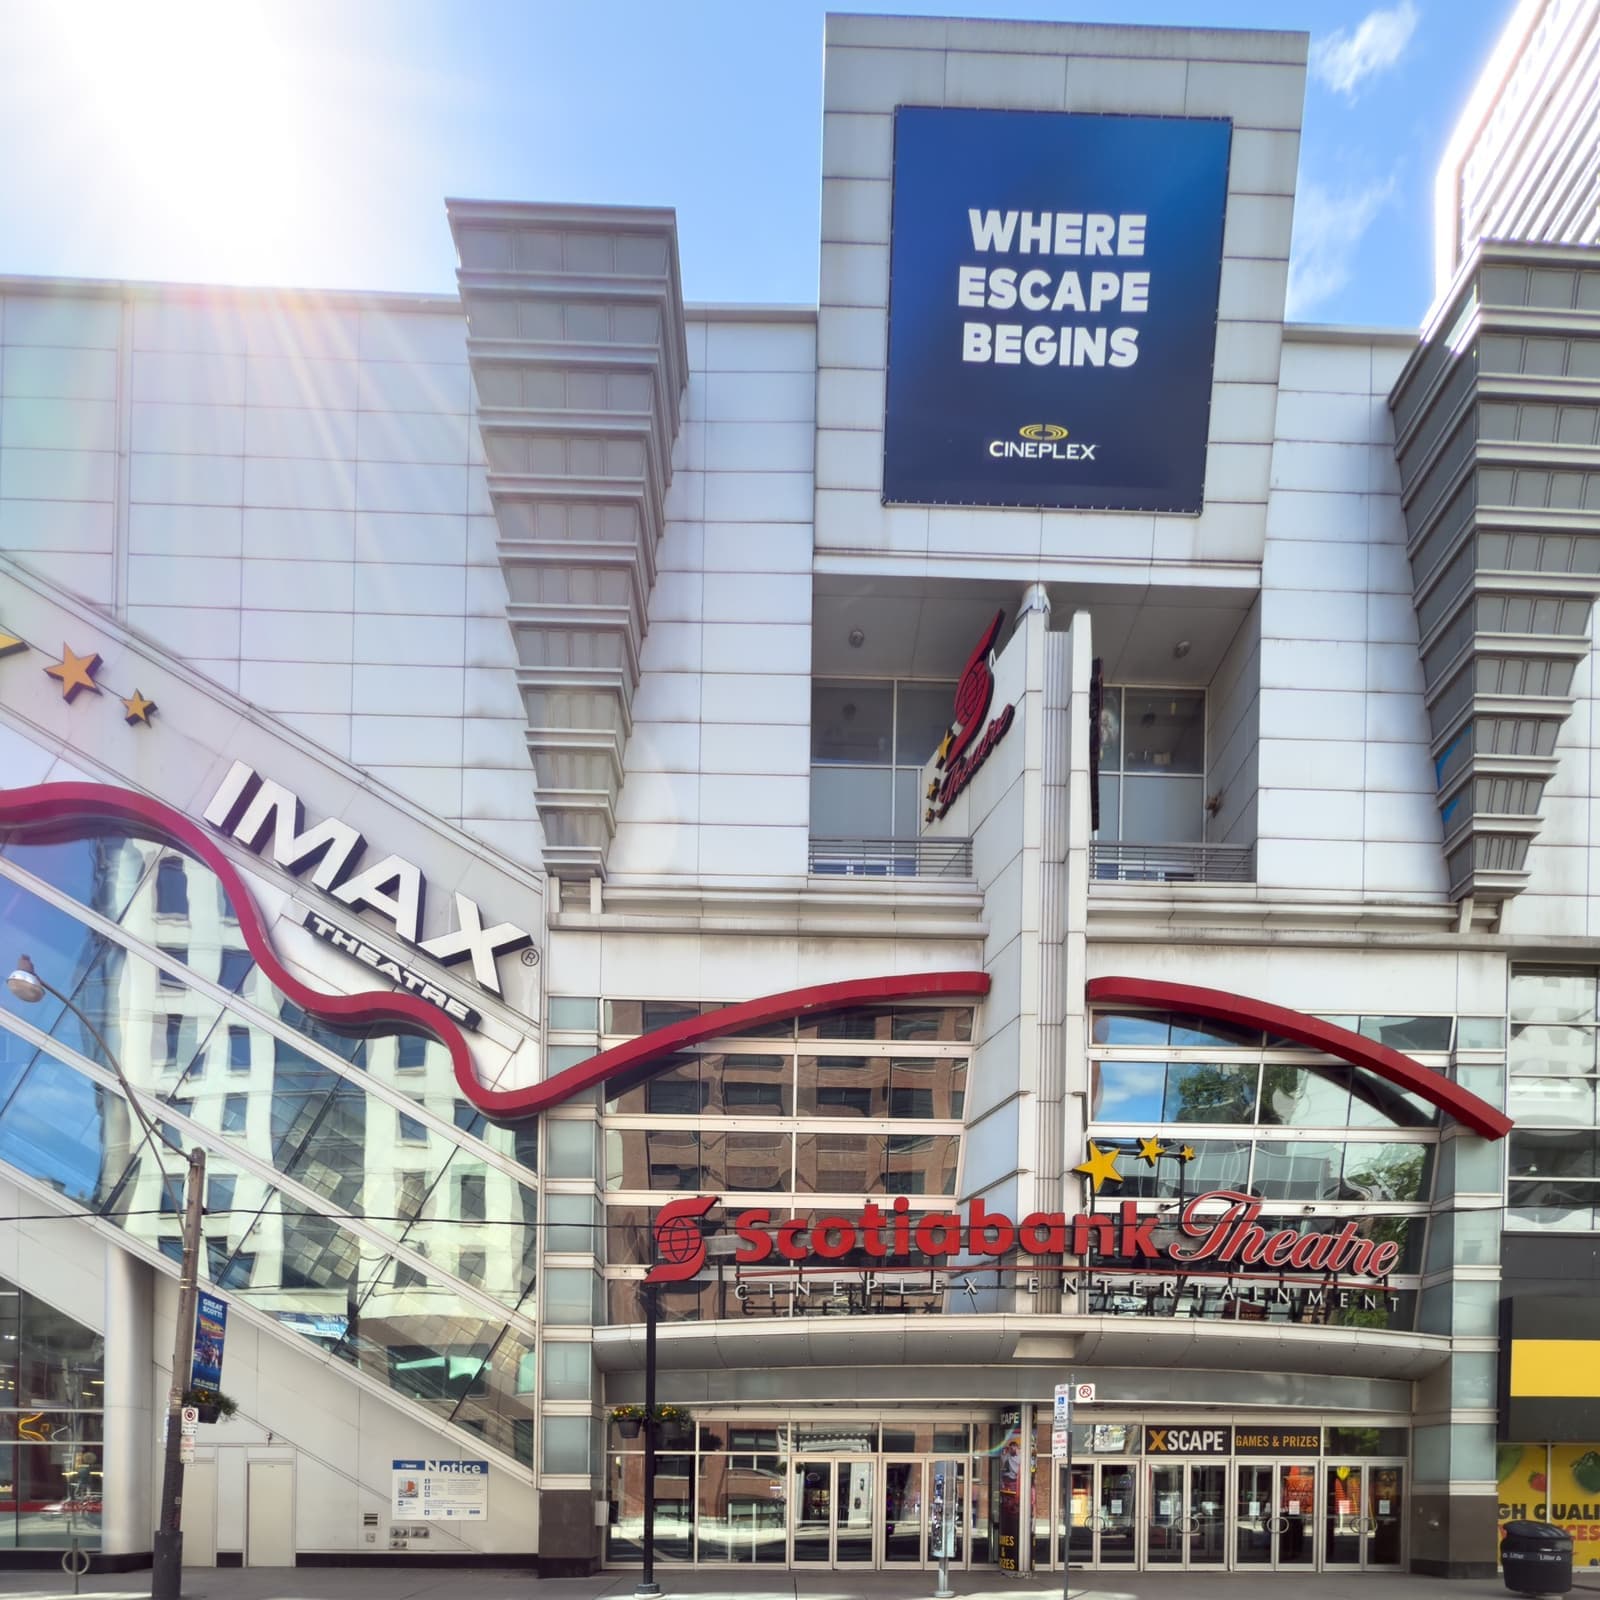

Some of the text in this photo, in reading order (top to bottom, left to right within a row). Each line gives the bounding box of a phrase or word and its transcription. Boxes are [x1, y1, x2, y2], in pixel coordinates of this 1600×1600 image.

[968, 208, 1147, 256] WHERE
[958, 266, 1150, 312] ESCAPE
[963, 322, 1139, 367] BEGINS
[989, 441, 1097, 460] CINEPLEX
[202, 759, 533, 999] IMAX
[308, 912, 480, 1026] THEATRE
[735, 1190, 1400, 1278] Scotiabank Theatre
[734, 1276, 1400, 1313] CINEPLEX ENTERTAINMENT
[1148, 1430, 1224, 1451] XSCAPE
[1235, 1435, 1319, 1448] GAMES & PRIZES
[425, 1460, 481, 1474] Notice
